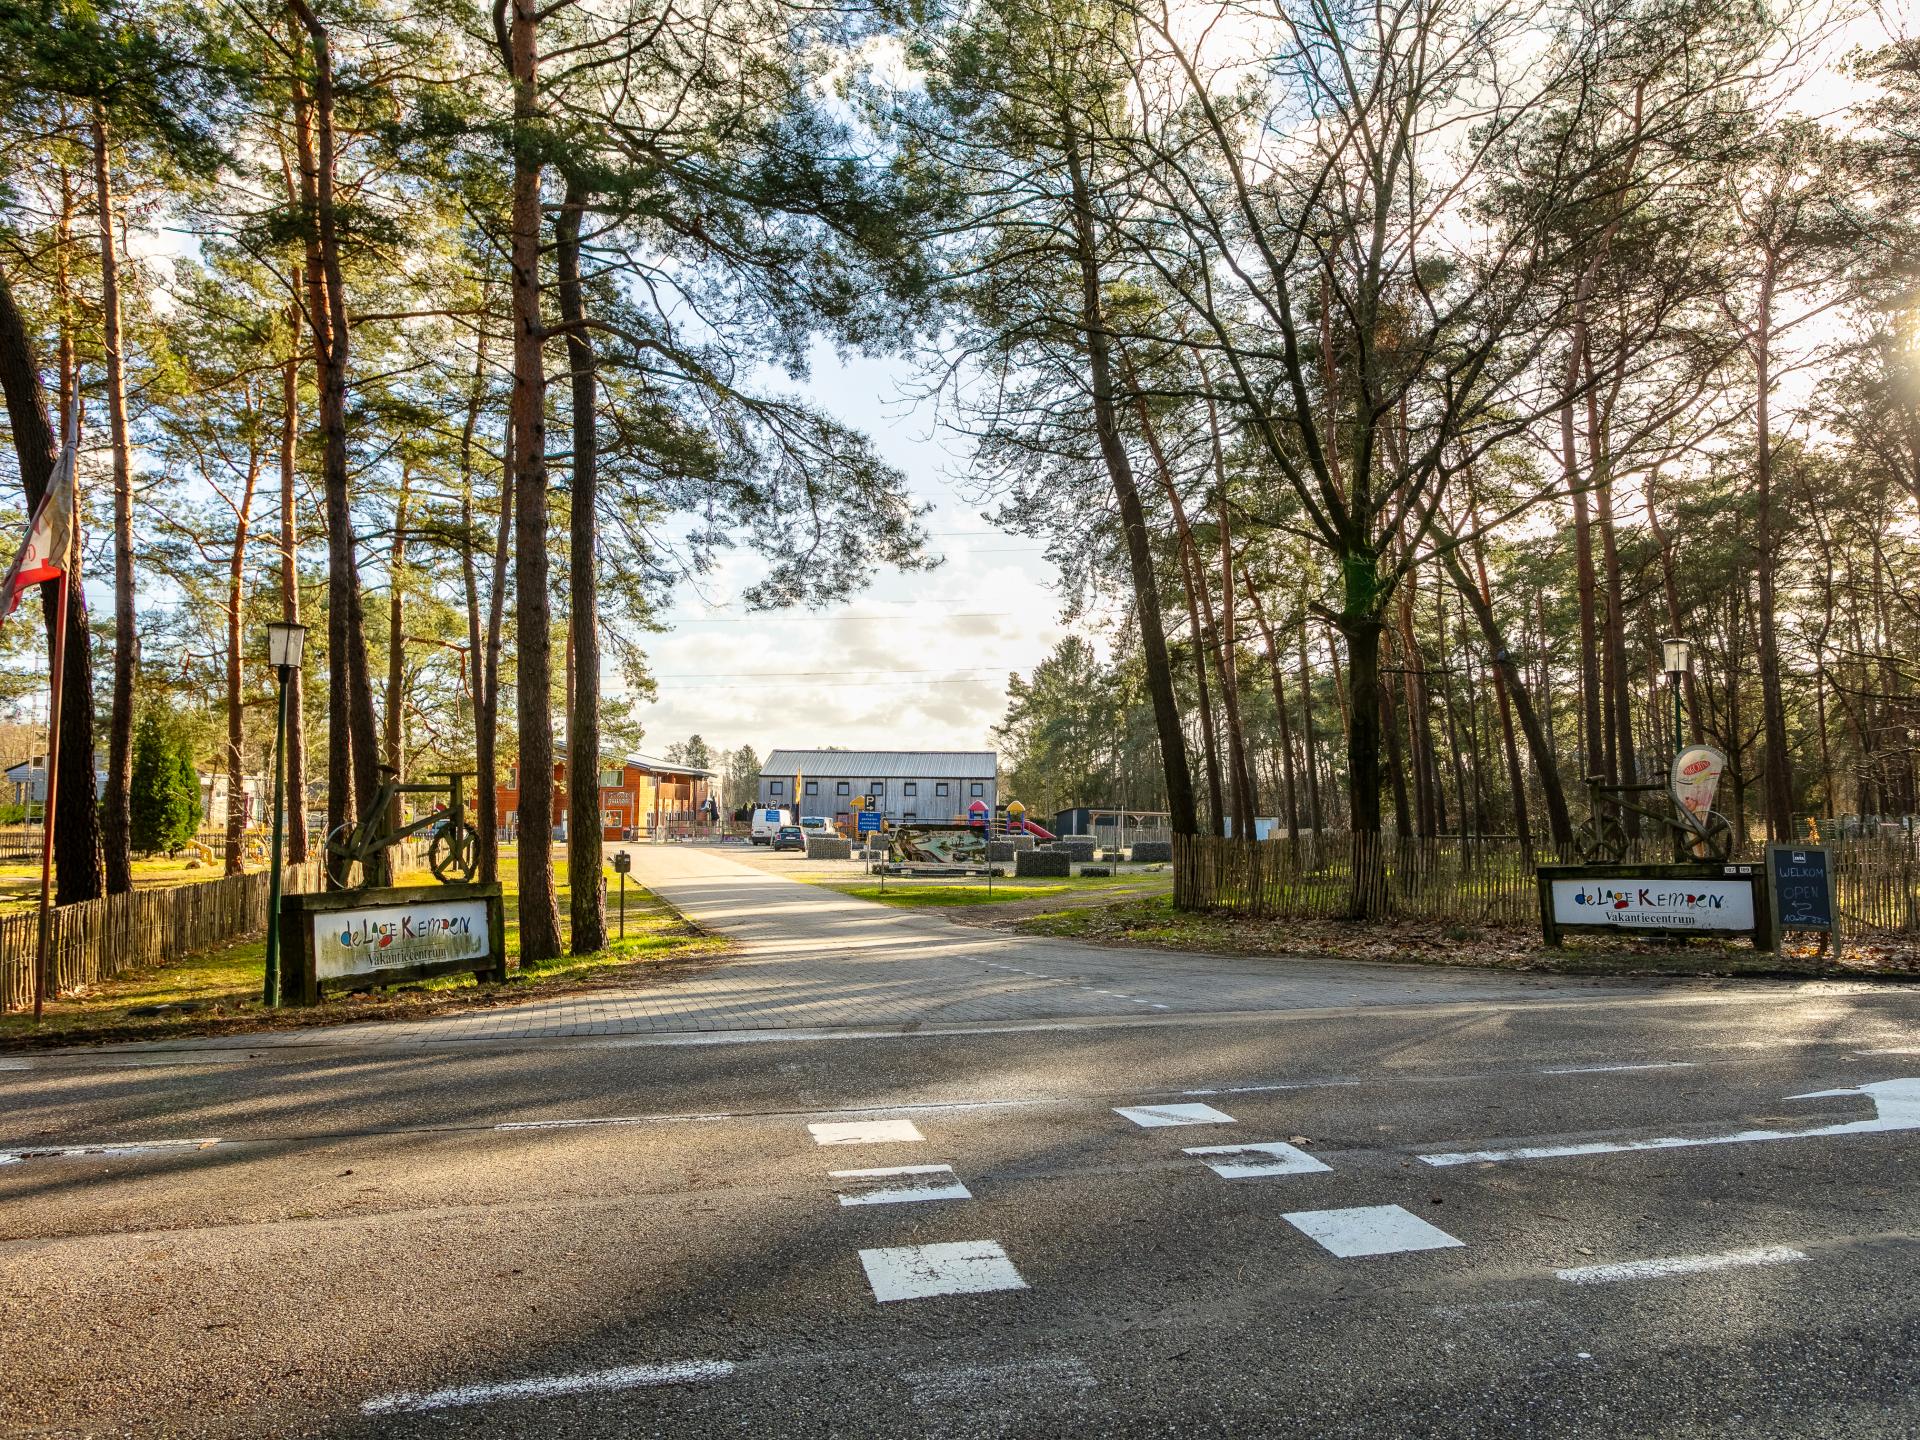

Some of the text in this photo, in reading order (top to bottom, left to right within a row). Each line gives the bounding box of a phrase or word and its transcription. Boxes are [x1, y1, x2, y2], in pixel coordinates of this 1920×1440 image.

[866, 796, 874, 805] P
[1780, 867, 1824, 878] WELKOM
[1783, 886, 1819, 899] OPEN
[1605, 910, 1696, 925] Vakantiecentrum
[368, 947, 447, 967] Vakantiecentrum
